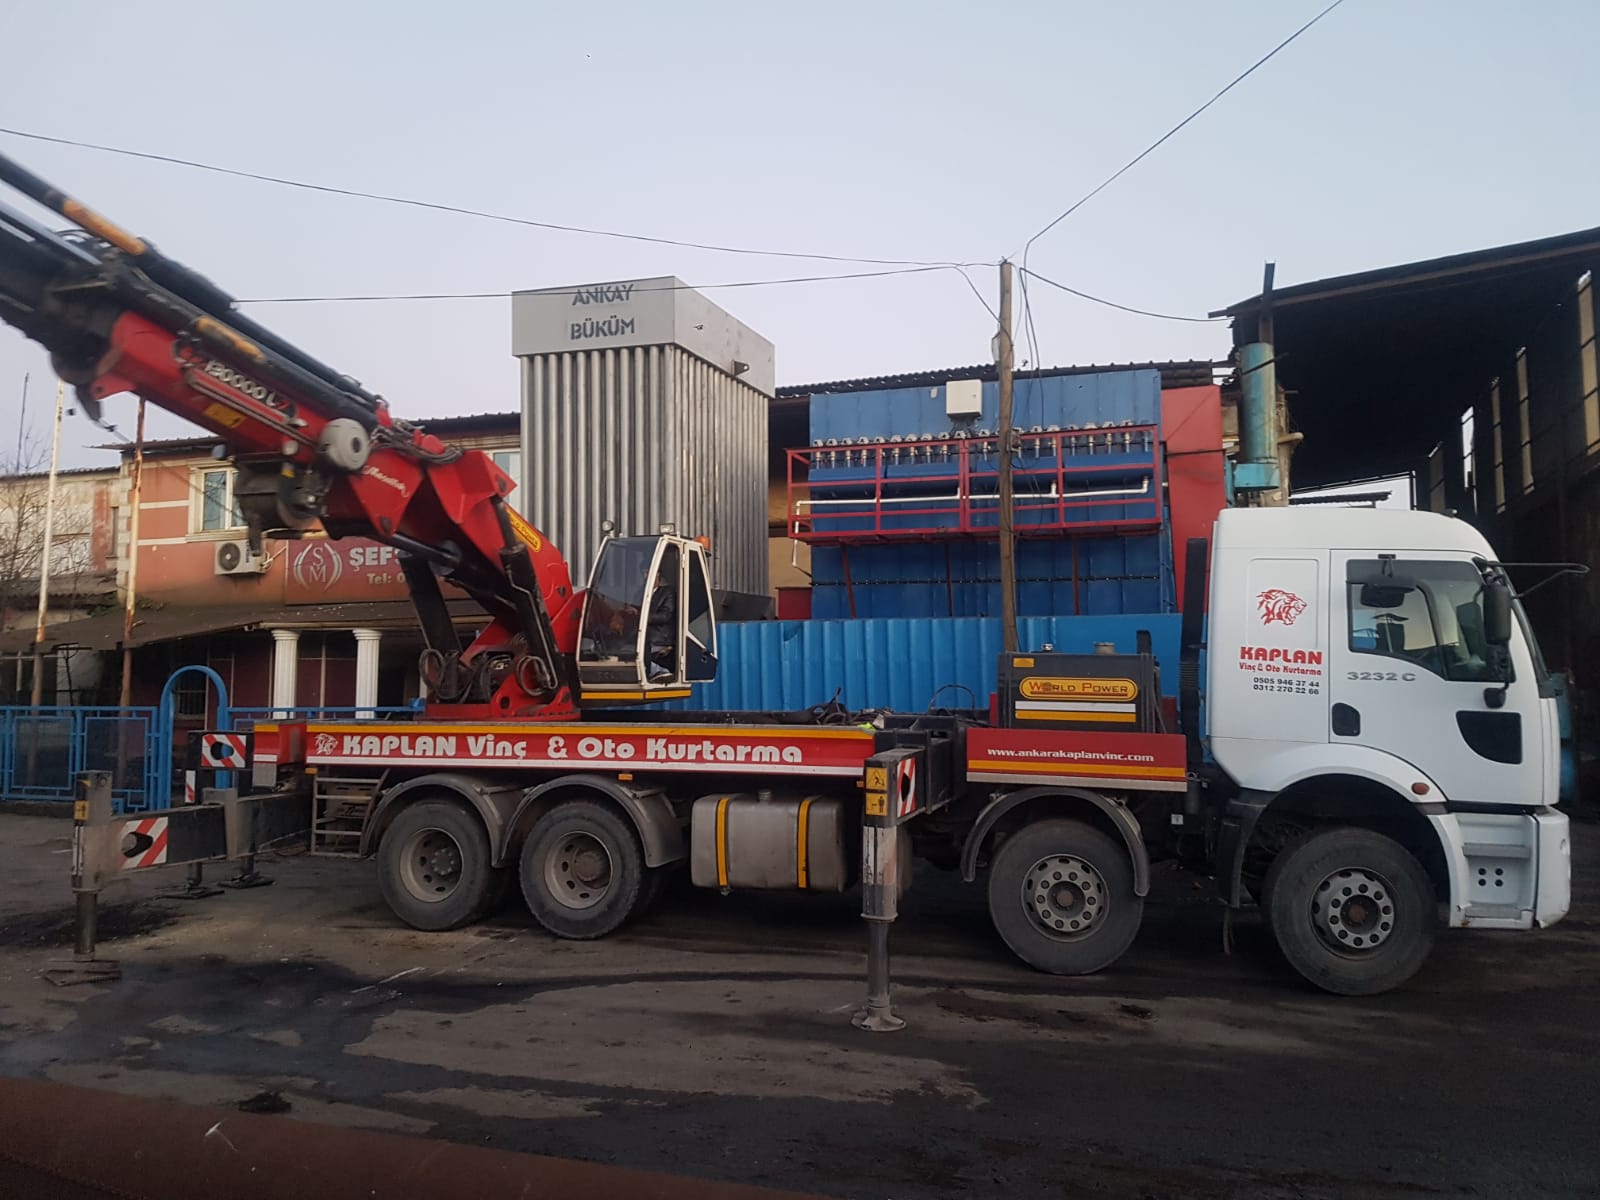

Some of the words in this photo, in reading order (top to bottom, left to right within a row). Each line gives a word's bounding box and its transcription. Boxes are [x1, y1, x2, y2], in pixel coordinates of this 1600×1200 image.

[572, 284, 634, 306] ANKAY
[570, 315, 635, 340] BÜKÜM
[367, 572, 392, 585] Tel:
[1240, 646, 1322, 665] KAPLAN
[1265, 664, 1280, 673] Oto
[1282, 666, 1322, 676] Kurtarma
[1347, 672, 1398, 682] 3232
[1402, 672, 1417, 682] C
[1253, 677, 1275, 685] 0505
[1277, 678, 1293, 686] 946
[1253, 684, 1275, 692] 0312
[342, 735, 456, 756] KAPLAN
[467, 734, 527, 760] Vinç
[547, 736, 569, 759] &
[577, 736, 635, 759] Oto
[646, 738, 803, 763] Kurtarma
[987, 748, 1155, 763] www.ankarakaplanvinc.com
